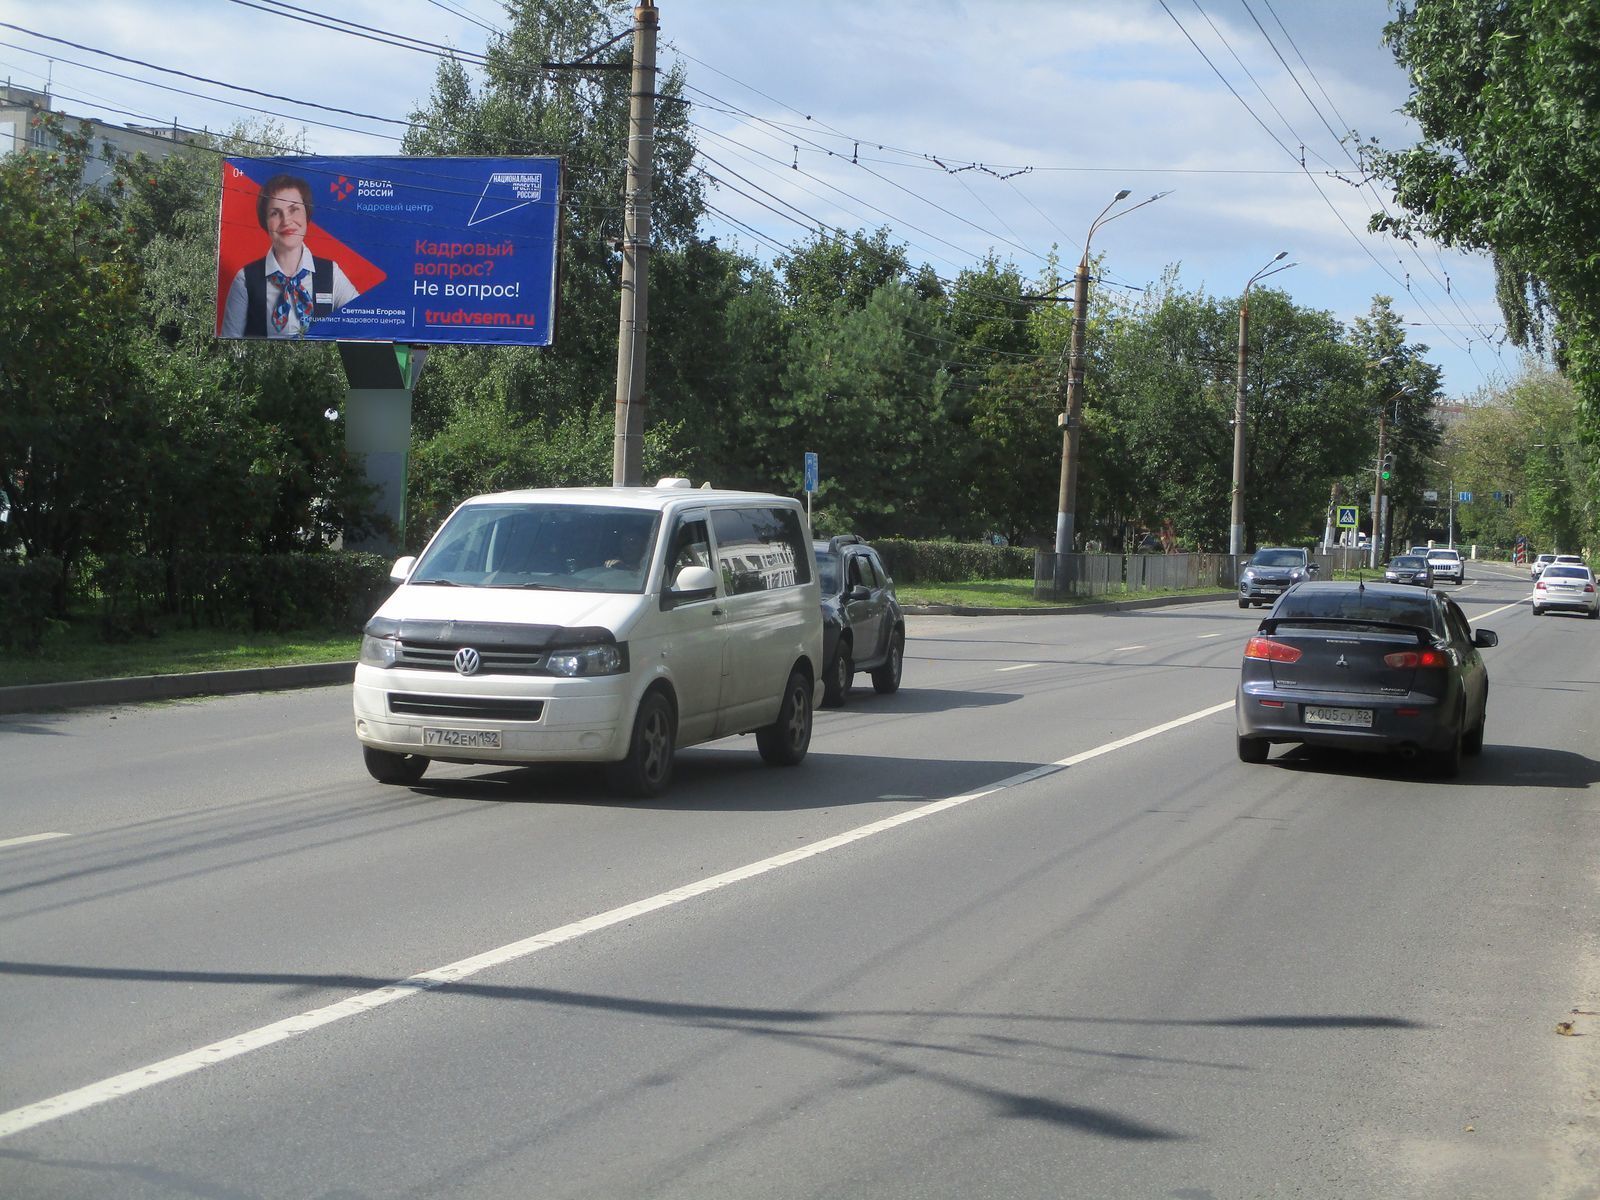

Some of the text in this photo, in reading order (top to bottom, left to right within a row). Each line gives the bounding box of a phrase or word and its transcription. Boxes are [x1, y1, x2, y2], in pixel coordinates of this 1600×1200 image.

[233, 168, 244, 178] 0+
[493, 175, 540, 183] НАЦИОНАЛЬНЫЕ
[358, 180, 393, 189] РАБОТА
[358, 189, 394, 198] РОССИИ
[516, 191, 539, 199] РОССИИ
[356, 202, 434, 213] Кадровый центр
[415, 240, 514, 258] Кадровый
[414, 260, 494, 279] вопрос?
[413, 280, 520, 300] Не вопрос!
[341, 308, 406, 317] Светлана Егорова
[342, 318, 379, 326] кадрового
[379, 318, 406, 327] центра
[424, 309, 536, 327] trudvsem.ru
